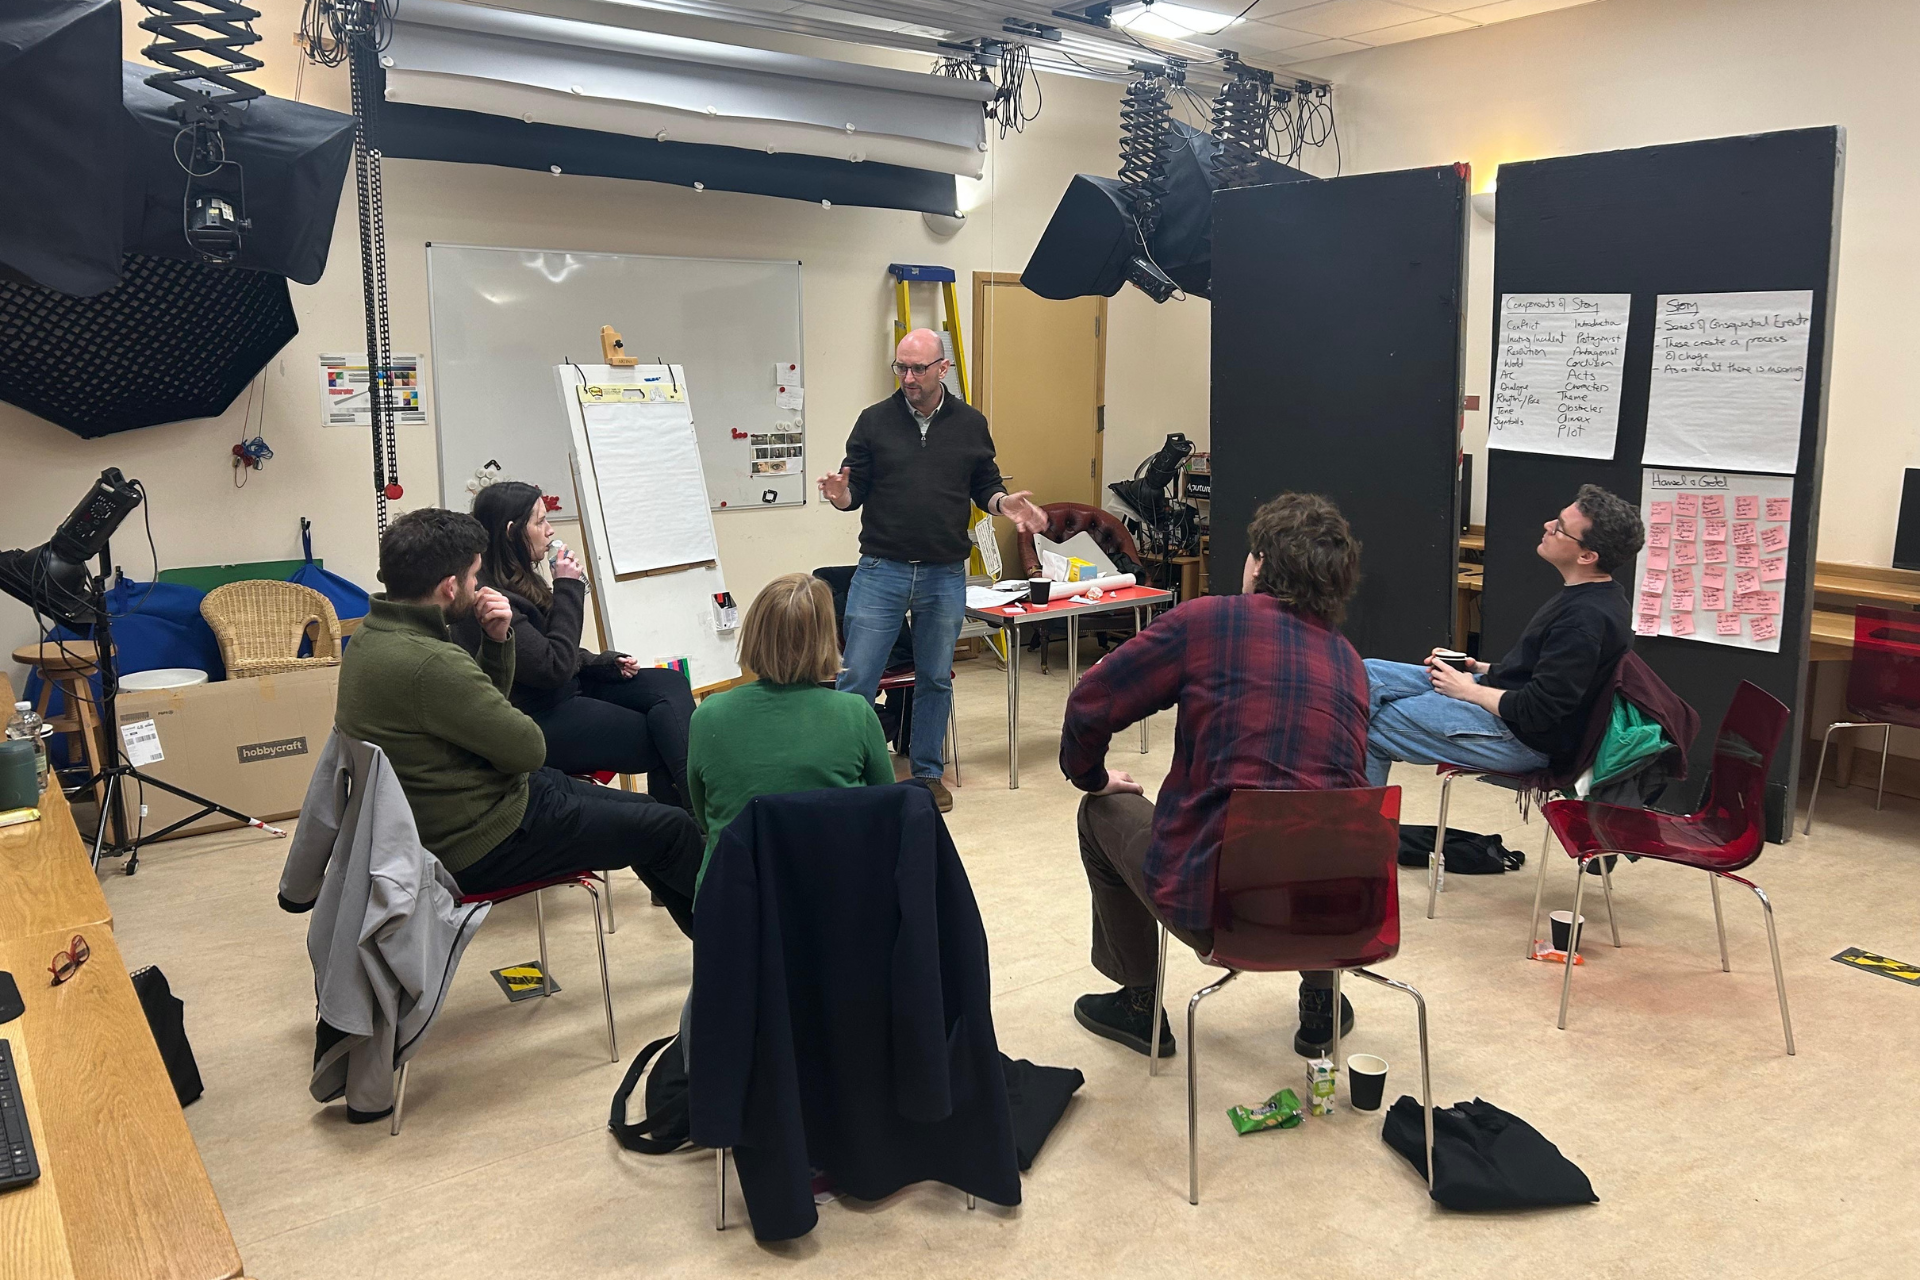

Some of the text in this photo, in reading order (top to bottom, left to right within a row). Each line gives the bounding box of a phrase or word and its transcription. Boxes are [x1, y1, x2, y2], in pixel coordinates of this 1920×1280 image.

[1506, 297, 1556, 313] Components
[1666, 298, 1699, 317] Story
[1507, 319, 1541, 330] Conflict
[1566, 368, 1596, 381] Acts
[1556, 390, 1589, 402] Theme
[1496, 406, 1515, 416] Tone
[1557, 424, 1587, 439] Plot
[242, 740, 303, 758] hobbycraft
